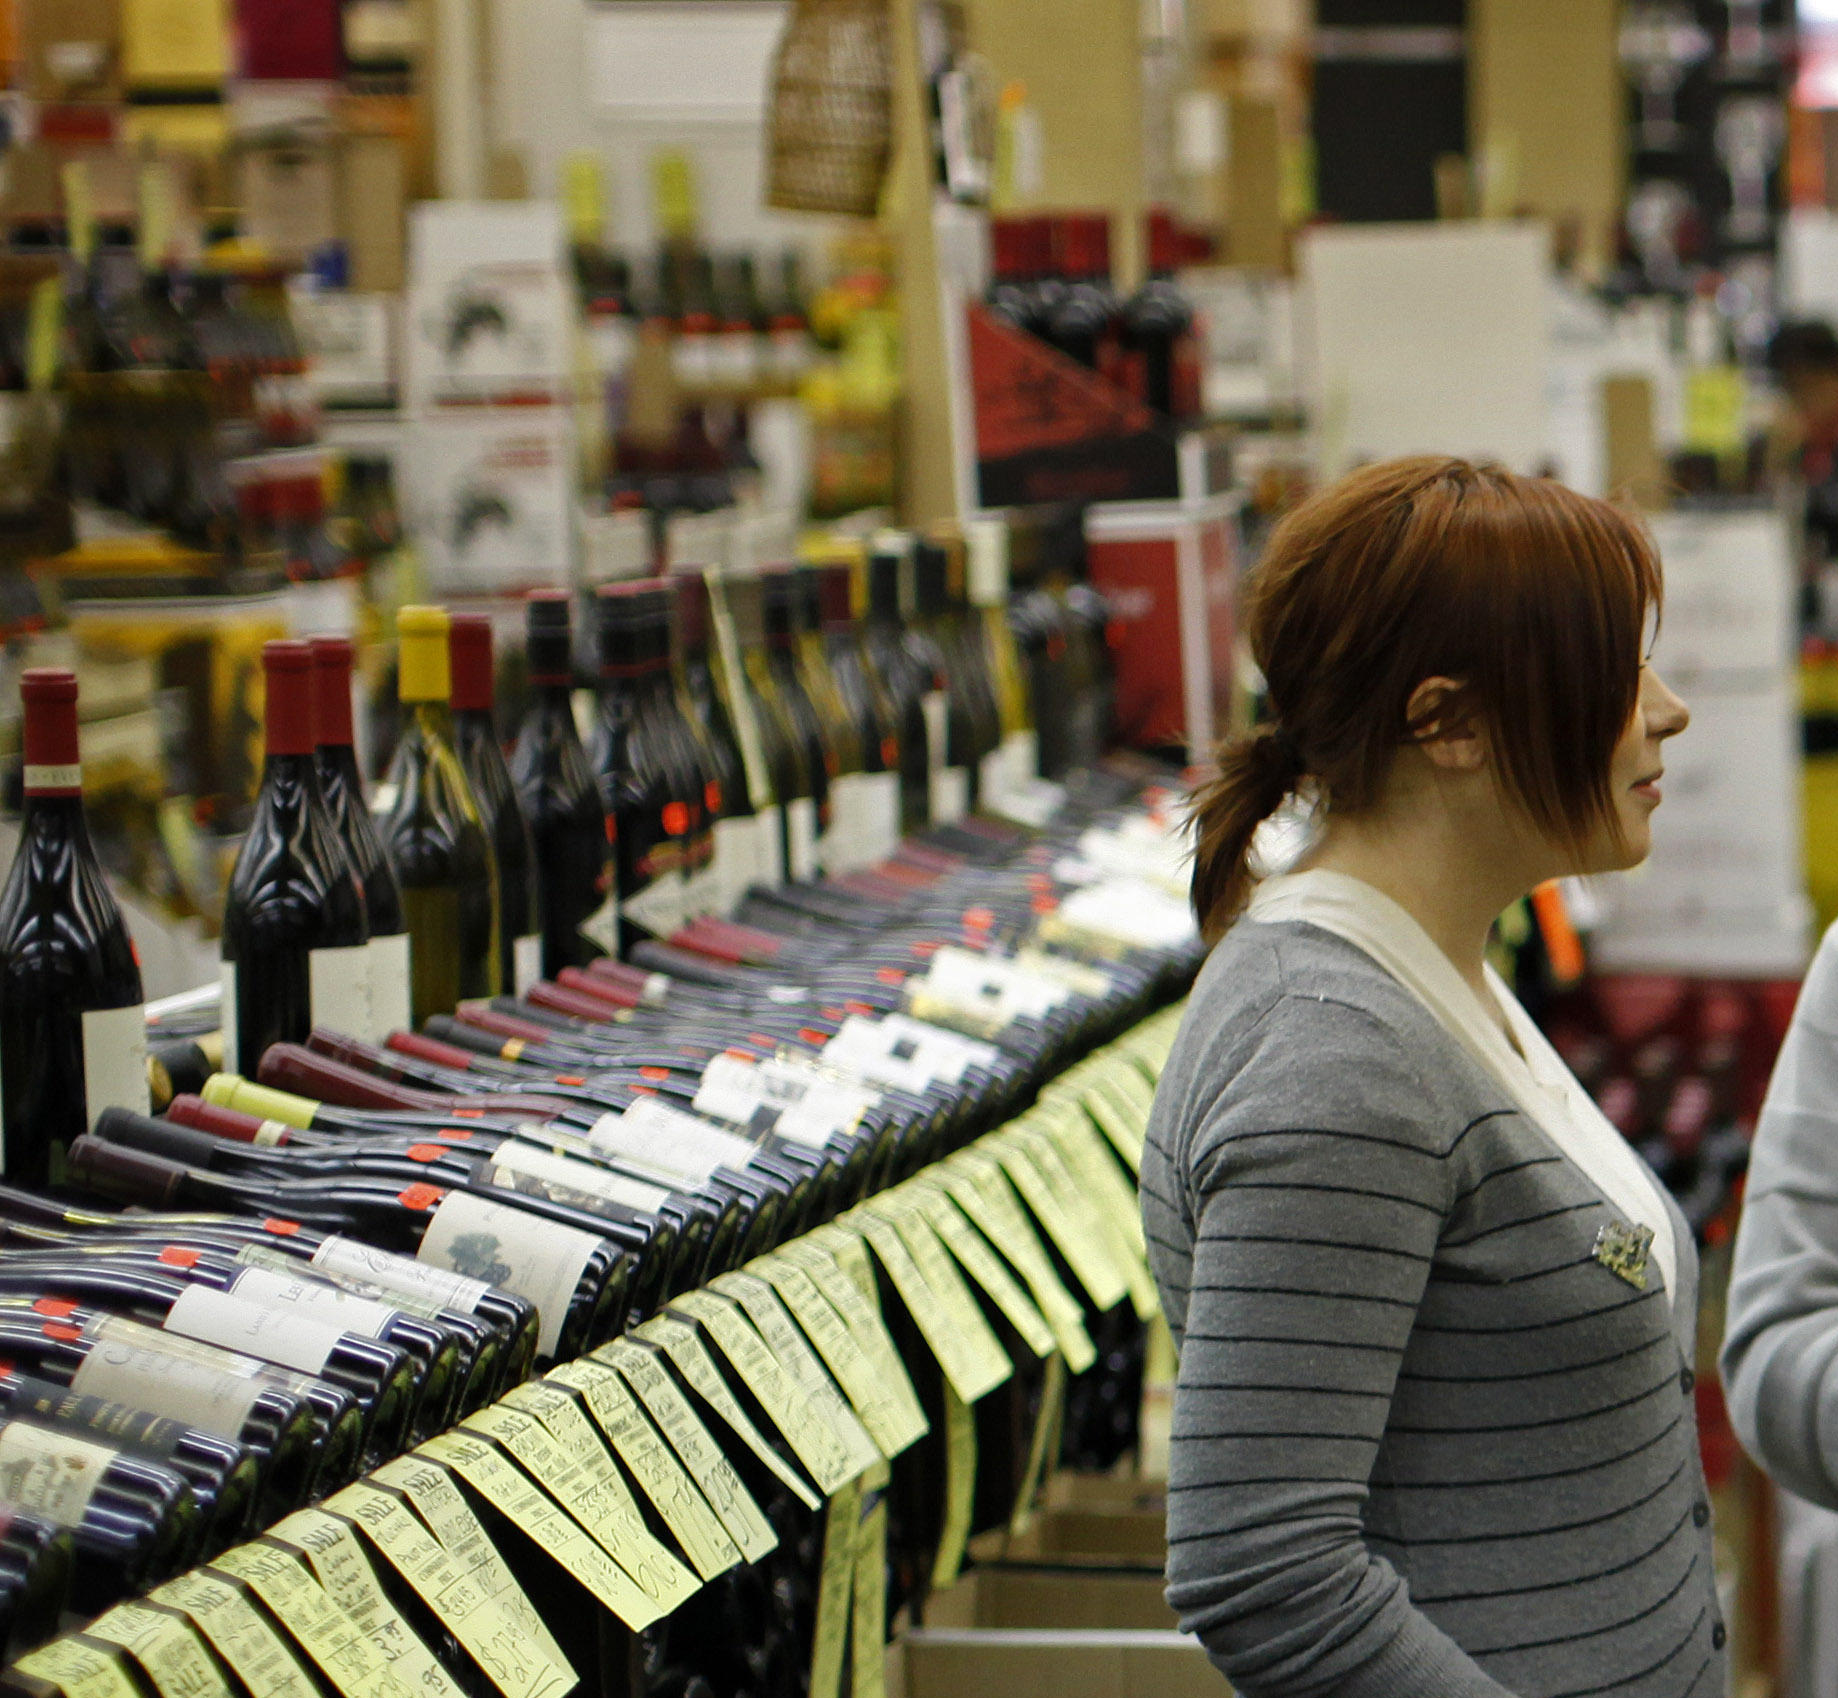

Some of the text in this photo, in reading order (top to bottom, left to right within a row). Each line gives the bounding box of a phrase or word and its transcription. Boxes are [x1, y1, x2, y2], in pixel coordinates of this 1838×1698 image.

[403, 1468, 445, 1497] SALE
[355, 1496, 396, 1527] SALE
[302, 1524, 345, 1555] SALE
